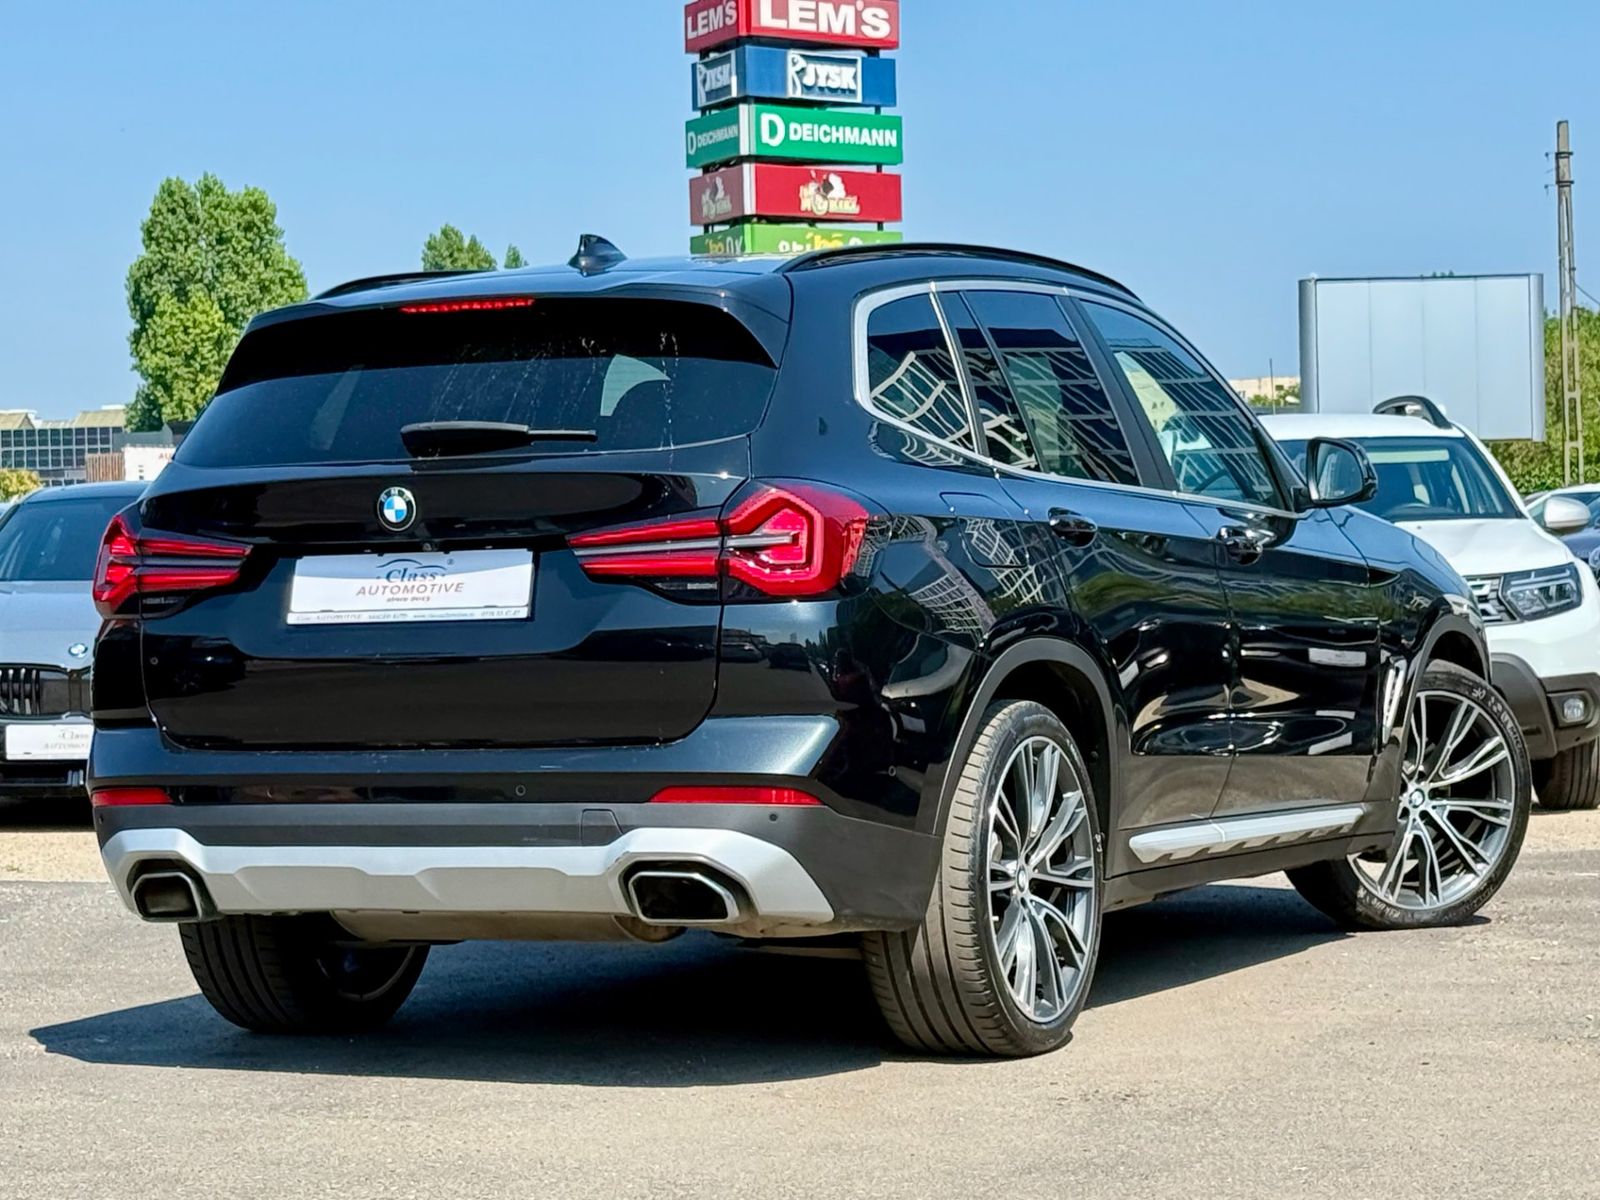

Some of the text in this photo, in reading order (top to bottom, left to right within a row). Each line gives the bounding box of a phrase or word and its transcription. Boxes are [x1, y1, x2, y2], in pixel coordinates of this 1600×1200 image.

[687, 0, 737, 39] LEM'S
[760, 0, 891, 39] LEM'S
[704, 63, 731, 92] JYSK
[802, 63, 857, 90] JYSK
[697, 124, 738, 147] DEICHMANN
[788, 122, 897, 147] DEICHMANN
[386, 568, 438, 583] Class
[356, 582, 464, 596] AUTOMOTIVE
